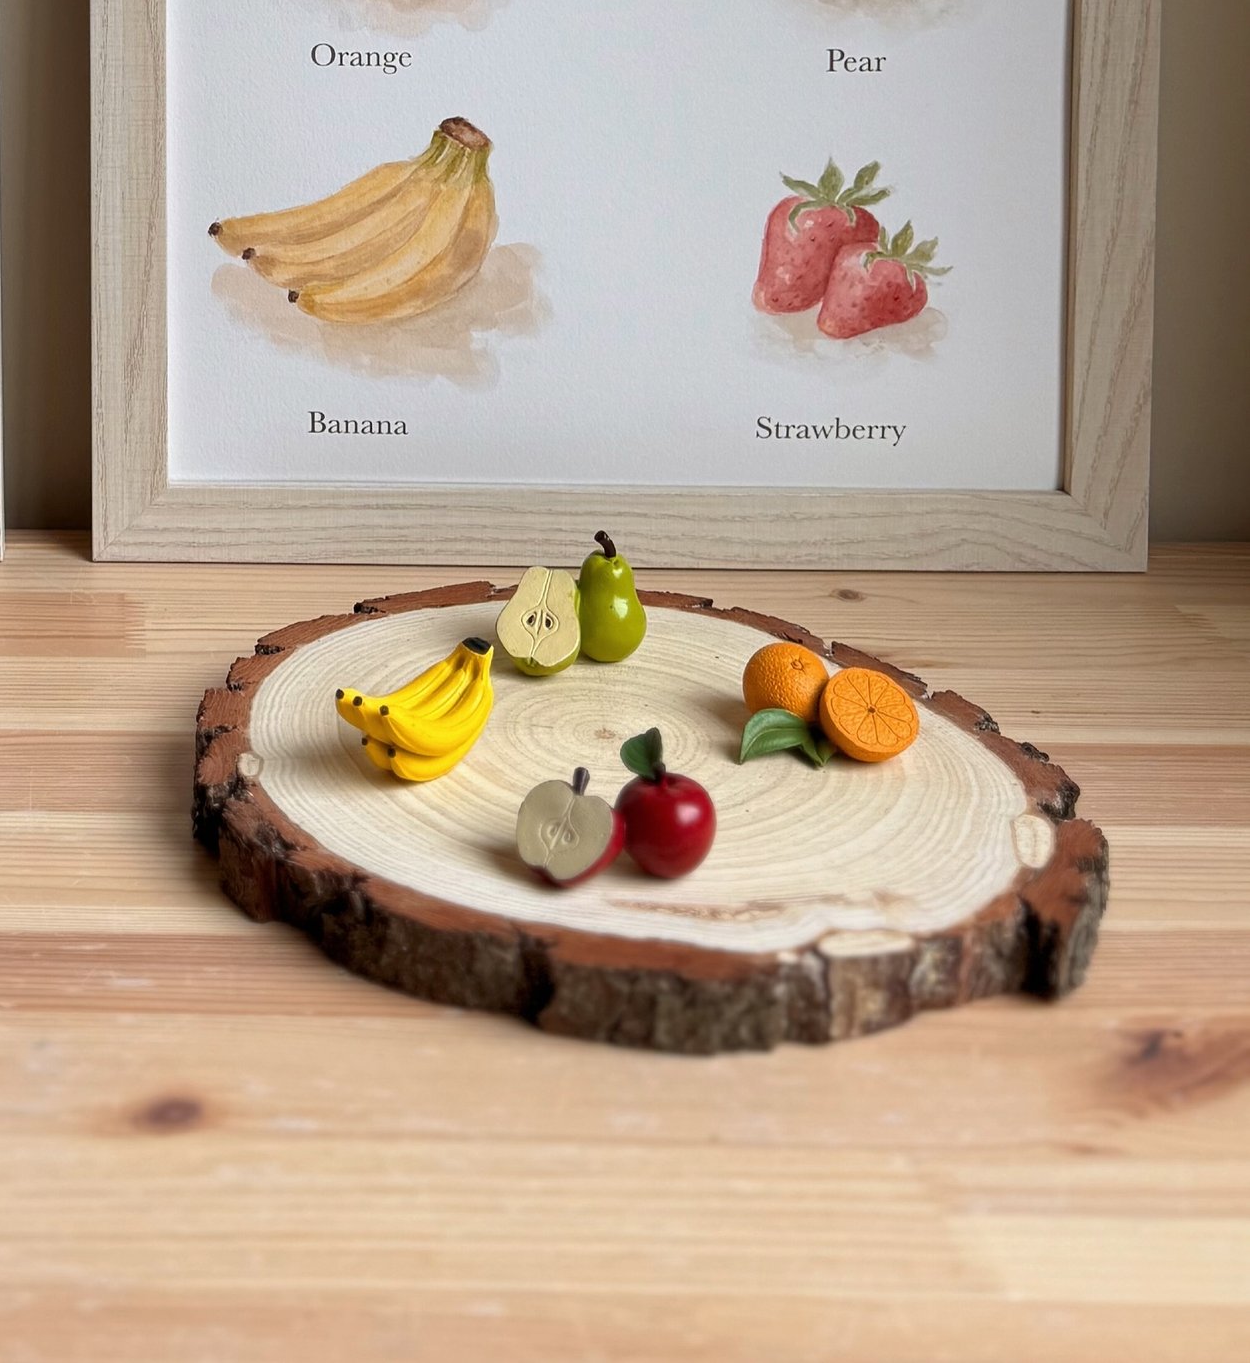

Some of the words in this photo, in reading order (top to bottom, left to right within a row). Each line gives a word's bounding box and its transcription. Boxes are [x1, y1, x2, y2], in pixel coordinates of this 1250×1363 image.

[311, 43, 413, 76] Orange
[827, 49, 888, 74] Pear
[308, 411, 410, 437] Banana
[756, 417, 908, 448] Strawberry
